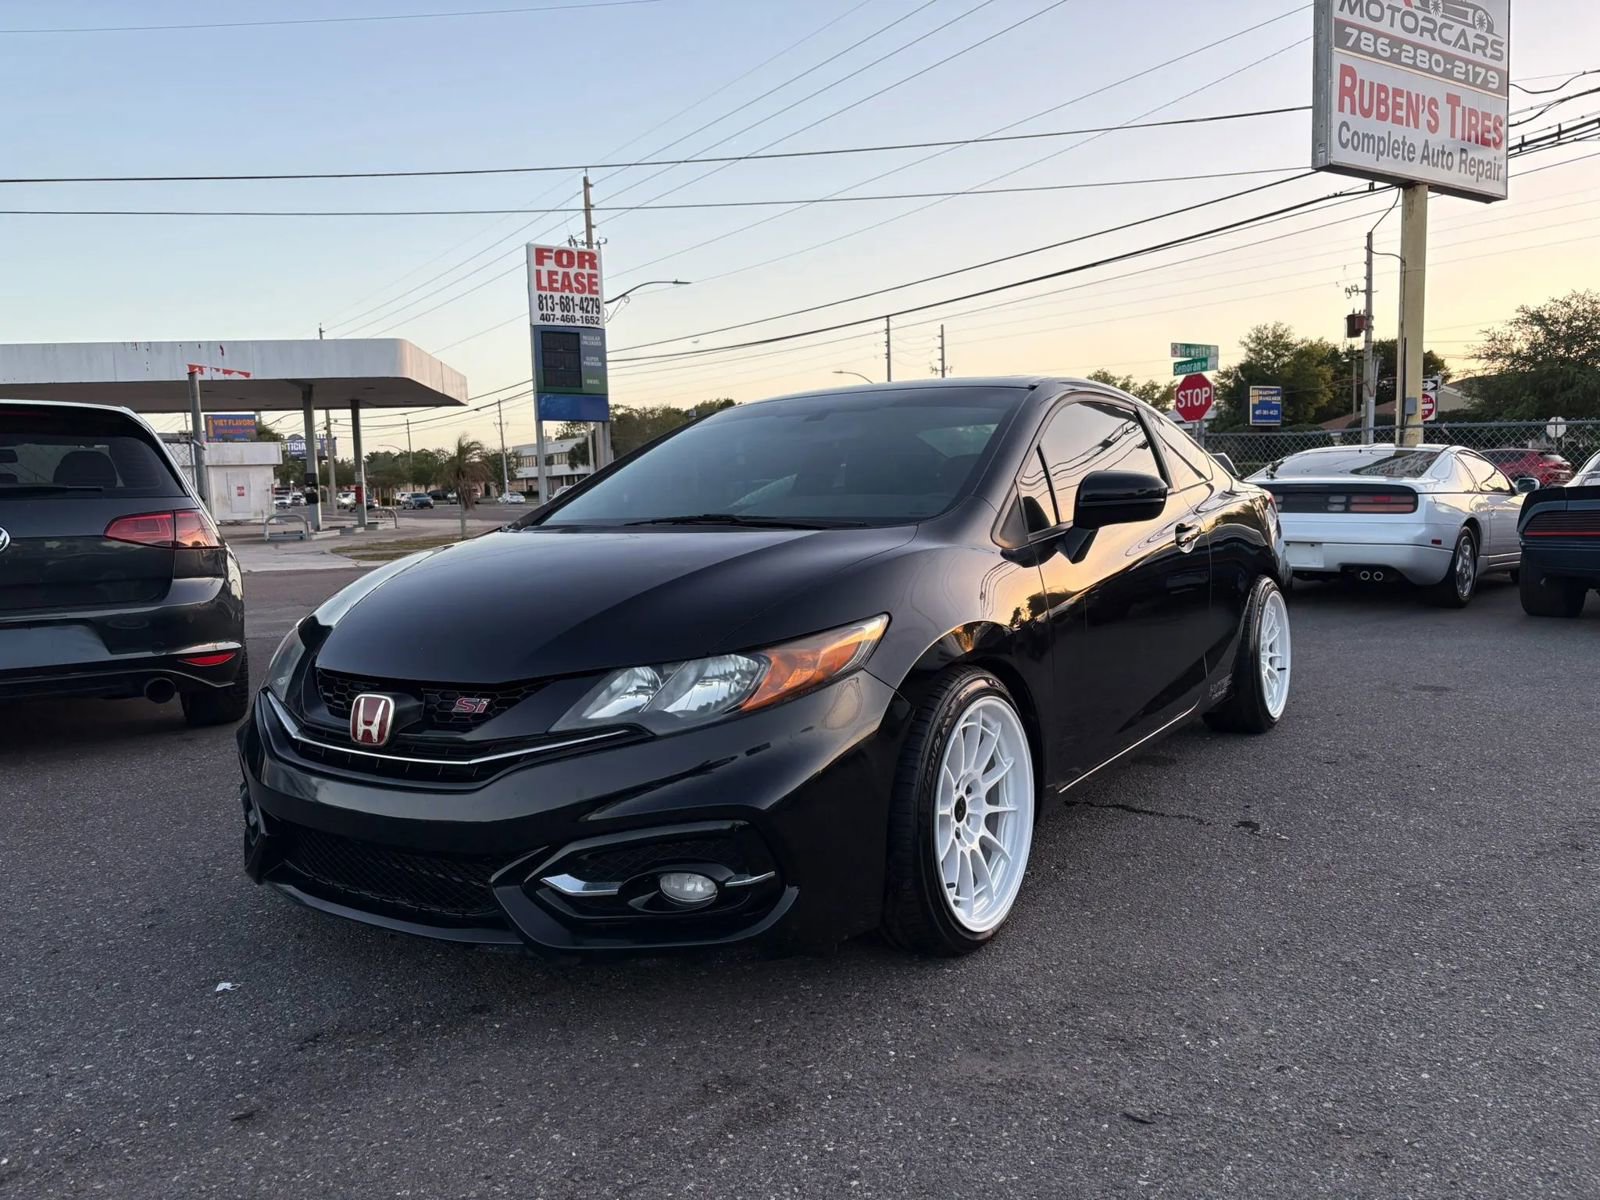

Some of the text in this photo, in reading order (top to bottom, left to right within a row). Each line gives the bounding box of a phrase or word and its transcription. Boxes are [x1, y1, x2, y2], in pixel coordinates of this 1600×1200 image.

[1338, 0, 1505, 62] MOTORCARS
[1344, 26, 1500, 89] 786-280-2179
[1446, 92, 1503, 150] TIRES
[1337, 120, 1503, 183] Complete Auto Repair
[535, 247, 598, 270] FOR
[535, 269, 599, 295] LEASE
[538, 293, 600, 315] 813-681-4279
[540, 312, 600, 325] 407-460-1652
[1177, 387, 1210, 408] STOP
[452, 696, 491, 714] Si
